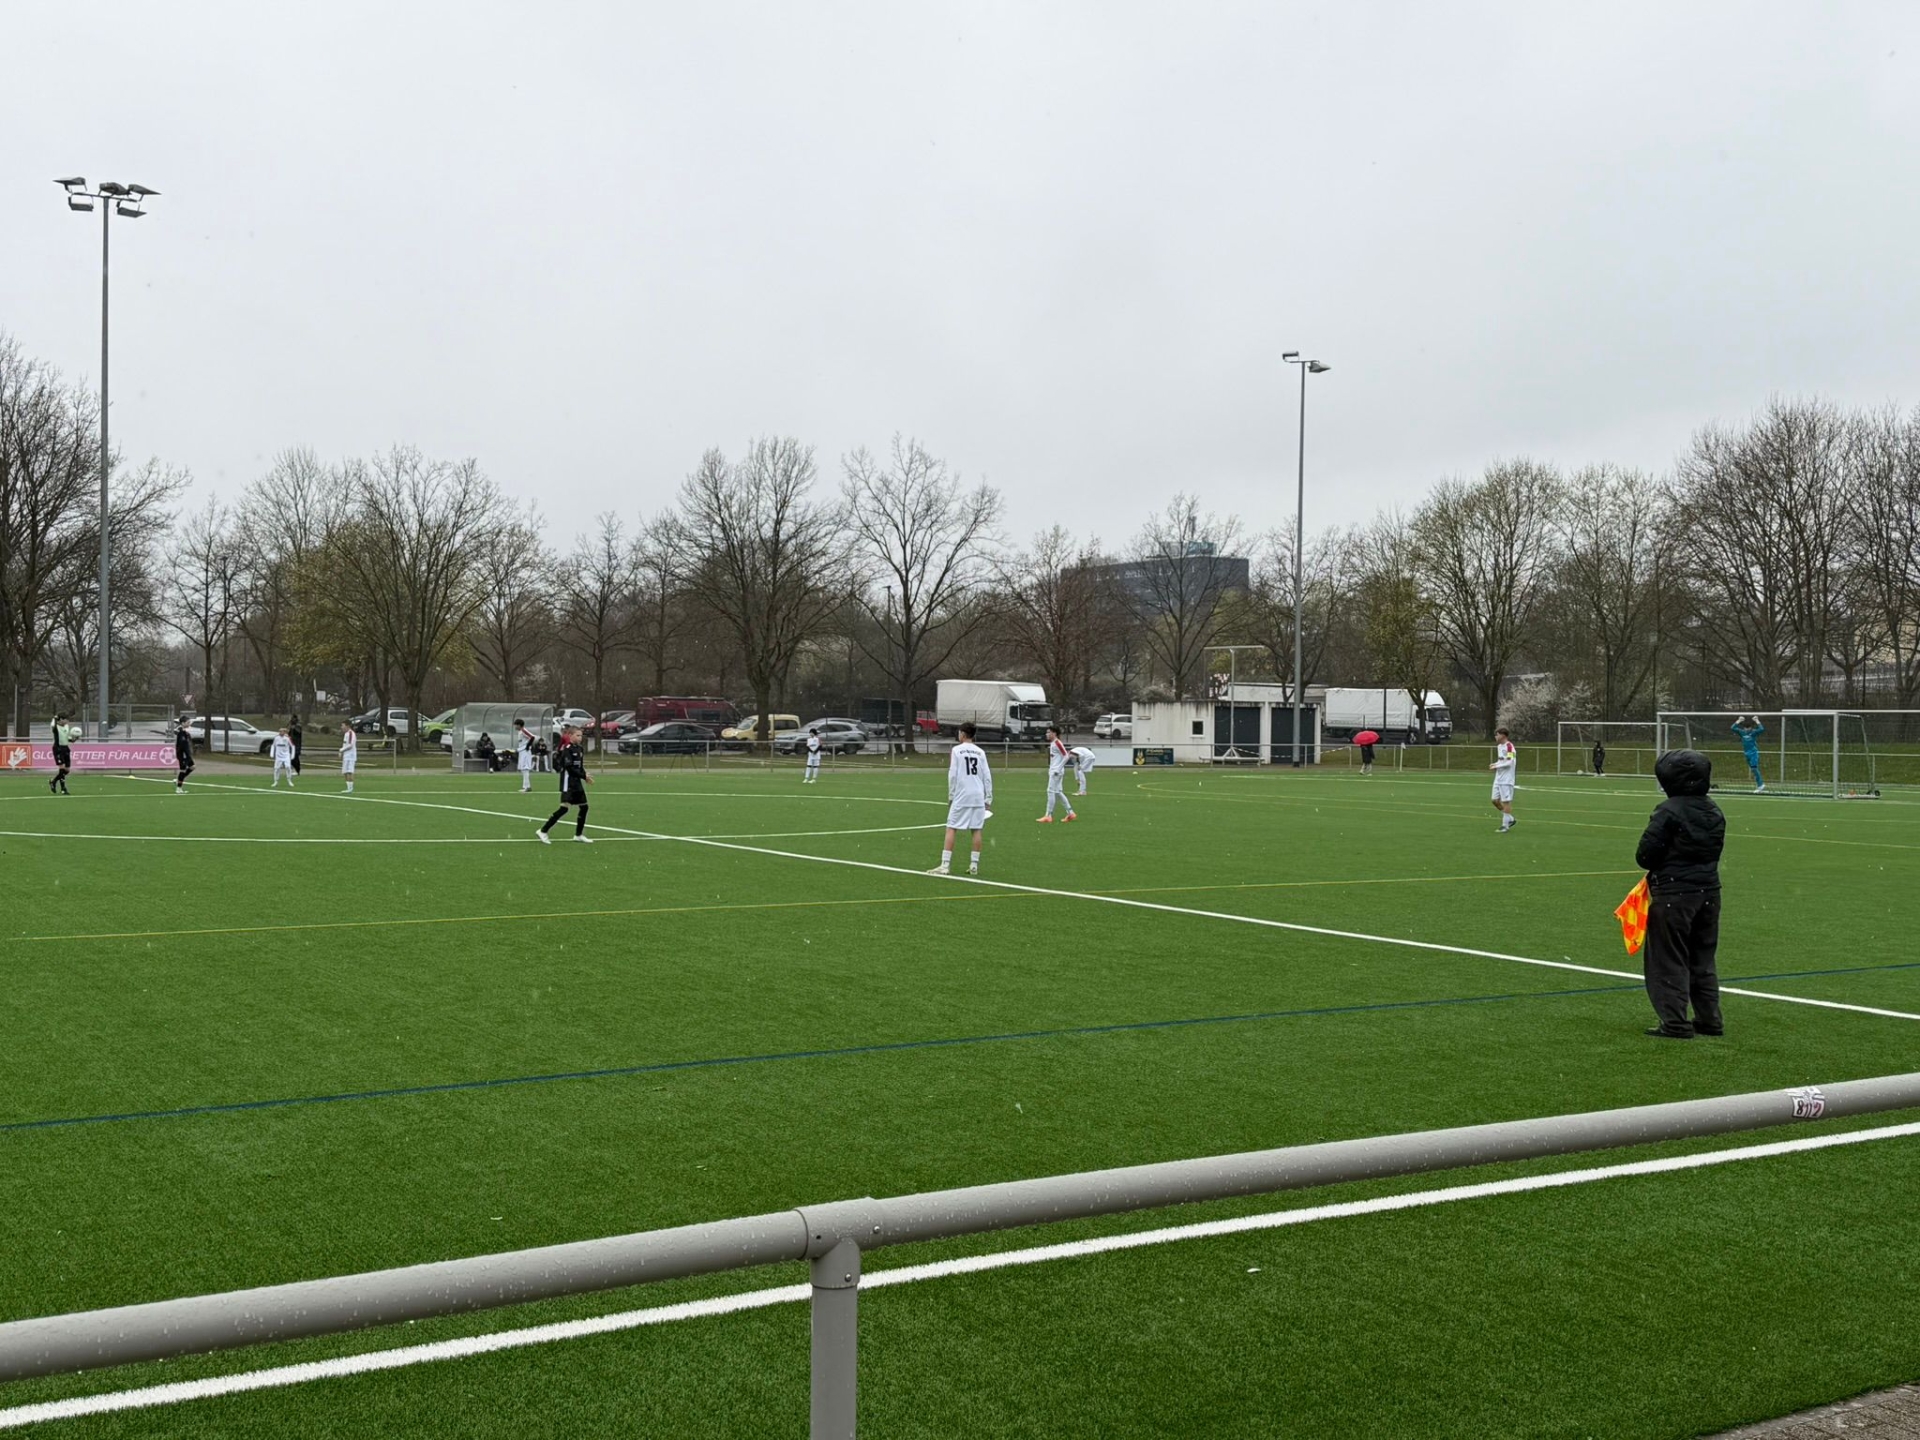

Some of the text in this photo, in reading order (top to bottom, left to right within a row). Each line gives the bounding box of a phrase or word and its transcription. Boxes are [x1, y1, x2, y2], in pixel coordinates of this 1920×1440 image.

[108, 749, 130, 760] FÜR
[131, 751, 157, 760] ALLE
[964, 756, 978, 775] 13
